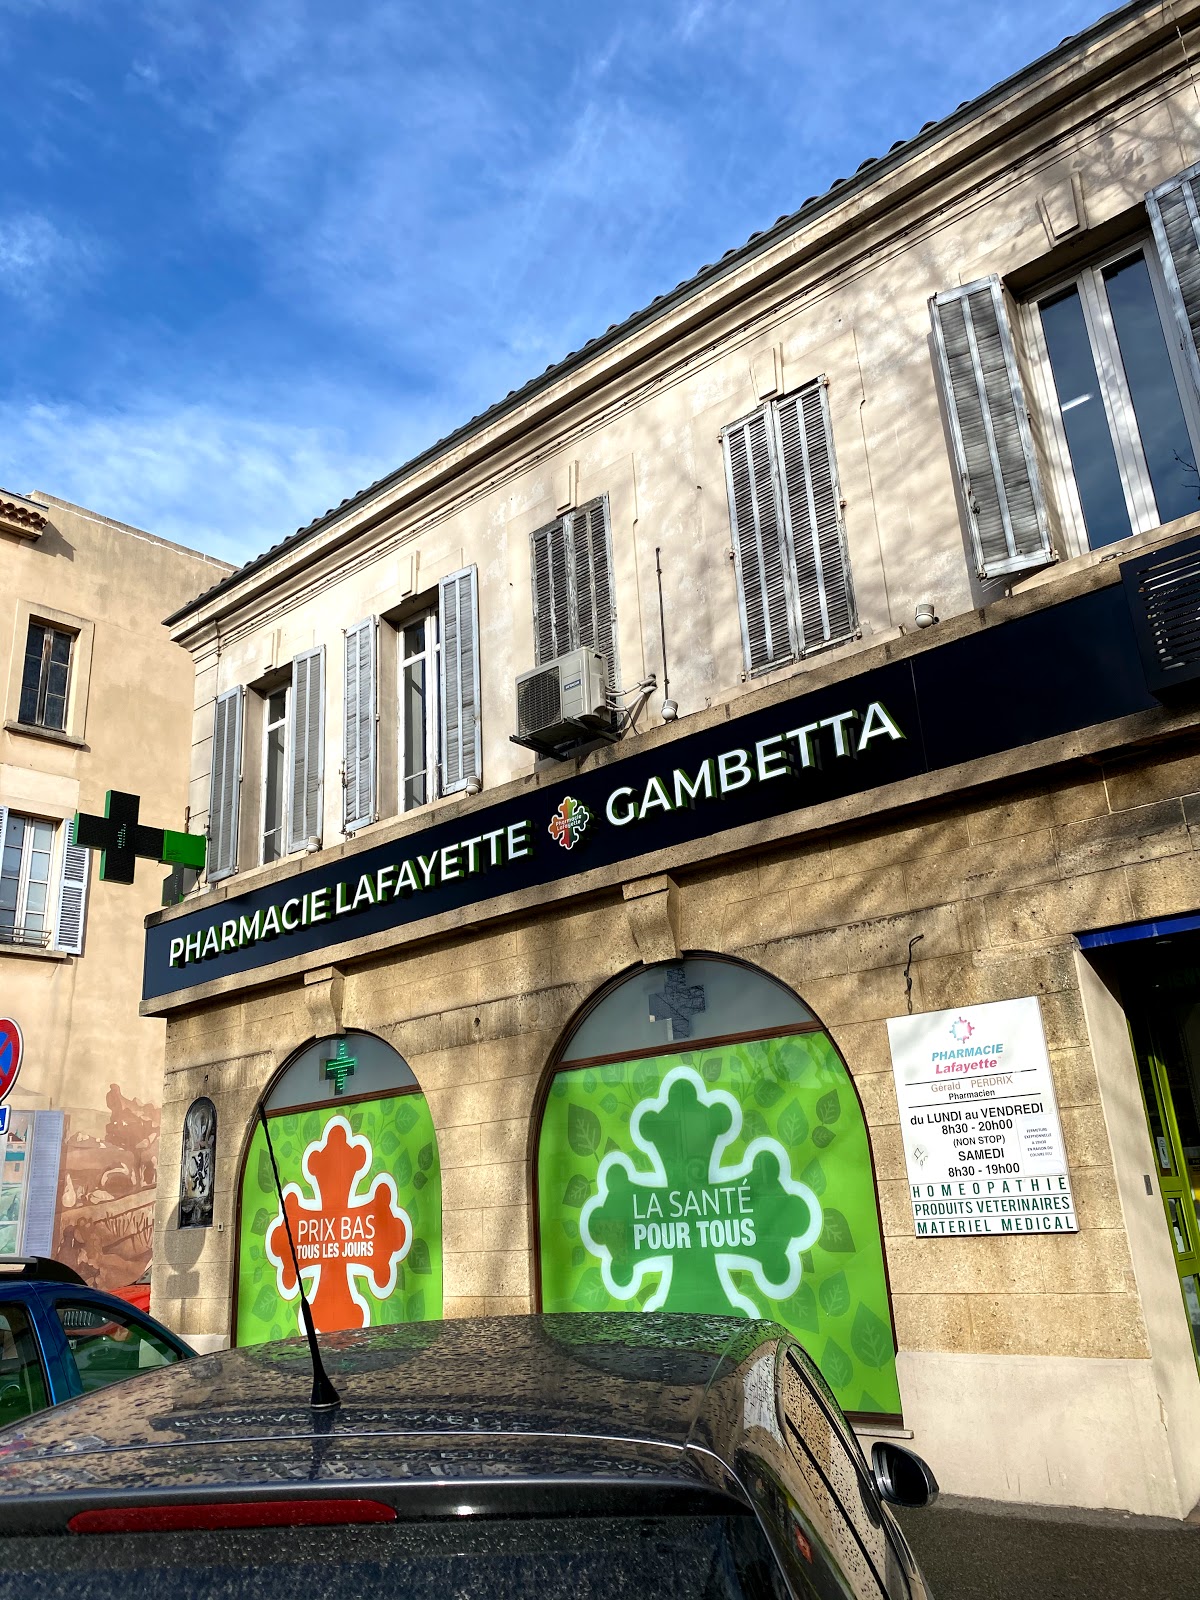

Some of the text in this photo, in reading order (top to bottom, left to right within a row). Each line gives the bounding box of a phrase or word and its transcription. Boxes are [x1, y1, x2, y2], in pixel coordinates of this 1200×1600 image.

[169, 700, 904, 968] PHARMACIE LAFAYETTE GAMBETTA
[931, 1043, 1004, 1062] PHARMACIE
[935, 1058, 998, 1075] Lafayette
[931, 1075, 1013, 1093] Gérald PERDRIX
[948, 1089, 995, 1102] Pharmacien
[910, 1102, 1044, 1126] du LUNDI au VENDREDI
[941, 1123, 968, 1135] 8h30
[978, 1118, 1013, 1132] 20h00
[953, 1134, 1006, 1148] (NON STOP)
[958, 1147, 1005, 1161] SAMEDI
[948, 1166, 975, 1178] 8h30
[985, 1162, 1020, 1175] 19h00
[913, 1177, 1067, 1199] HOMEOPATHIE
[632, 1177, 754, 1220] LA SANTÉ
[914, 1196, 1070, 1217] PRODUITS VETERINAIRES
[297, 1214, 376, 1243] PRIX BAS
[633, 1218, 757, 1250] POUR TOUS
[917, 1216, 1074, 1235] MATERIEL MEDICAL
[296, 1241, 374, 1260] TOUS LES JOURS
